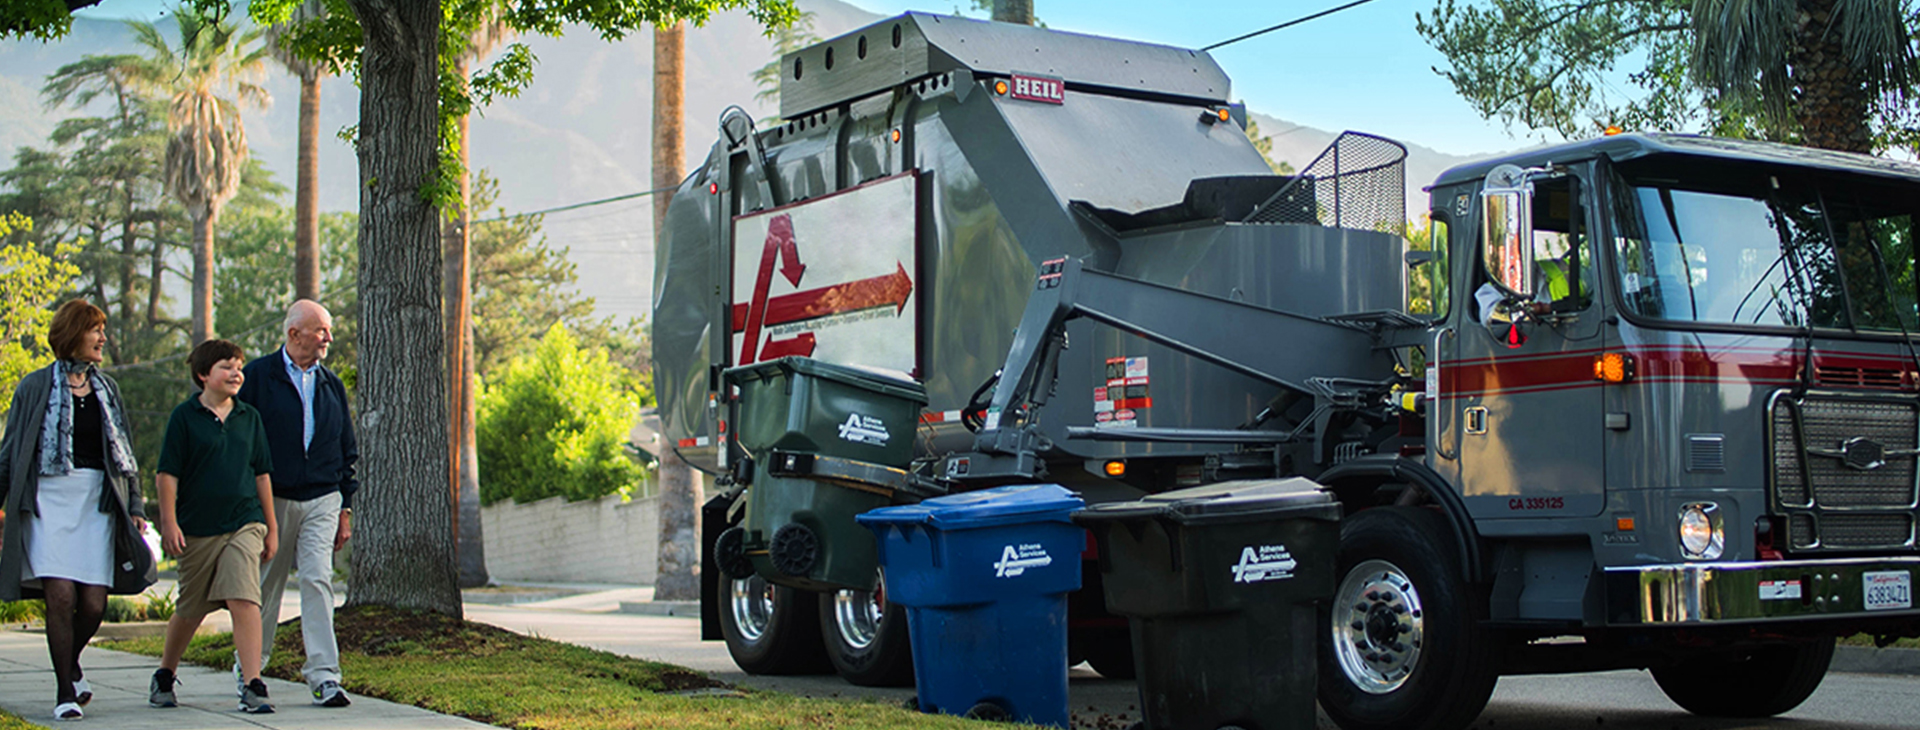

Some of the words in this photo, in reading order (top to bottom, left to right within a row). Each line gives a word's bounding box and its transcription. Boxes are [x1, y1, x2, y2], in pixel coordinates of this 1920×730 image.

[1015, 78, 1062, 99] HEIL
[1508, 498, 1524, 510] CA
[1526, 497, 1564, 509] 335125
[1019, 543, 1041, 551] Athens
[1259, 545, 1285, 553] Athens
[1020, 549, 1046, 558] Services
[1260, 552, 1290, 561] Services
